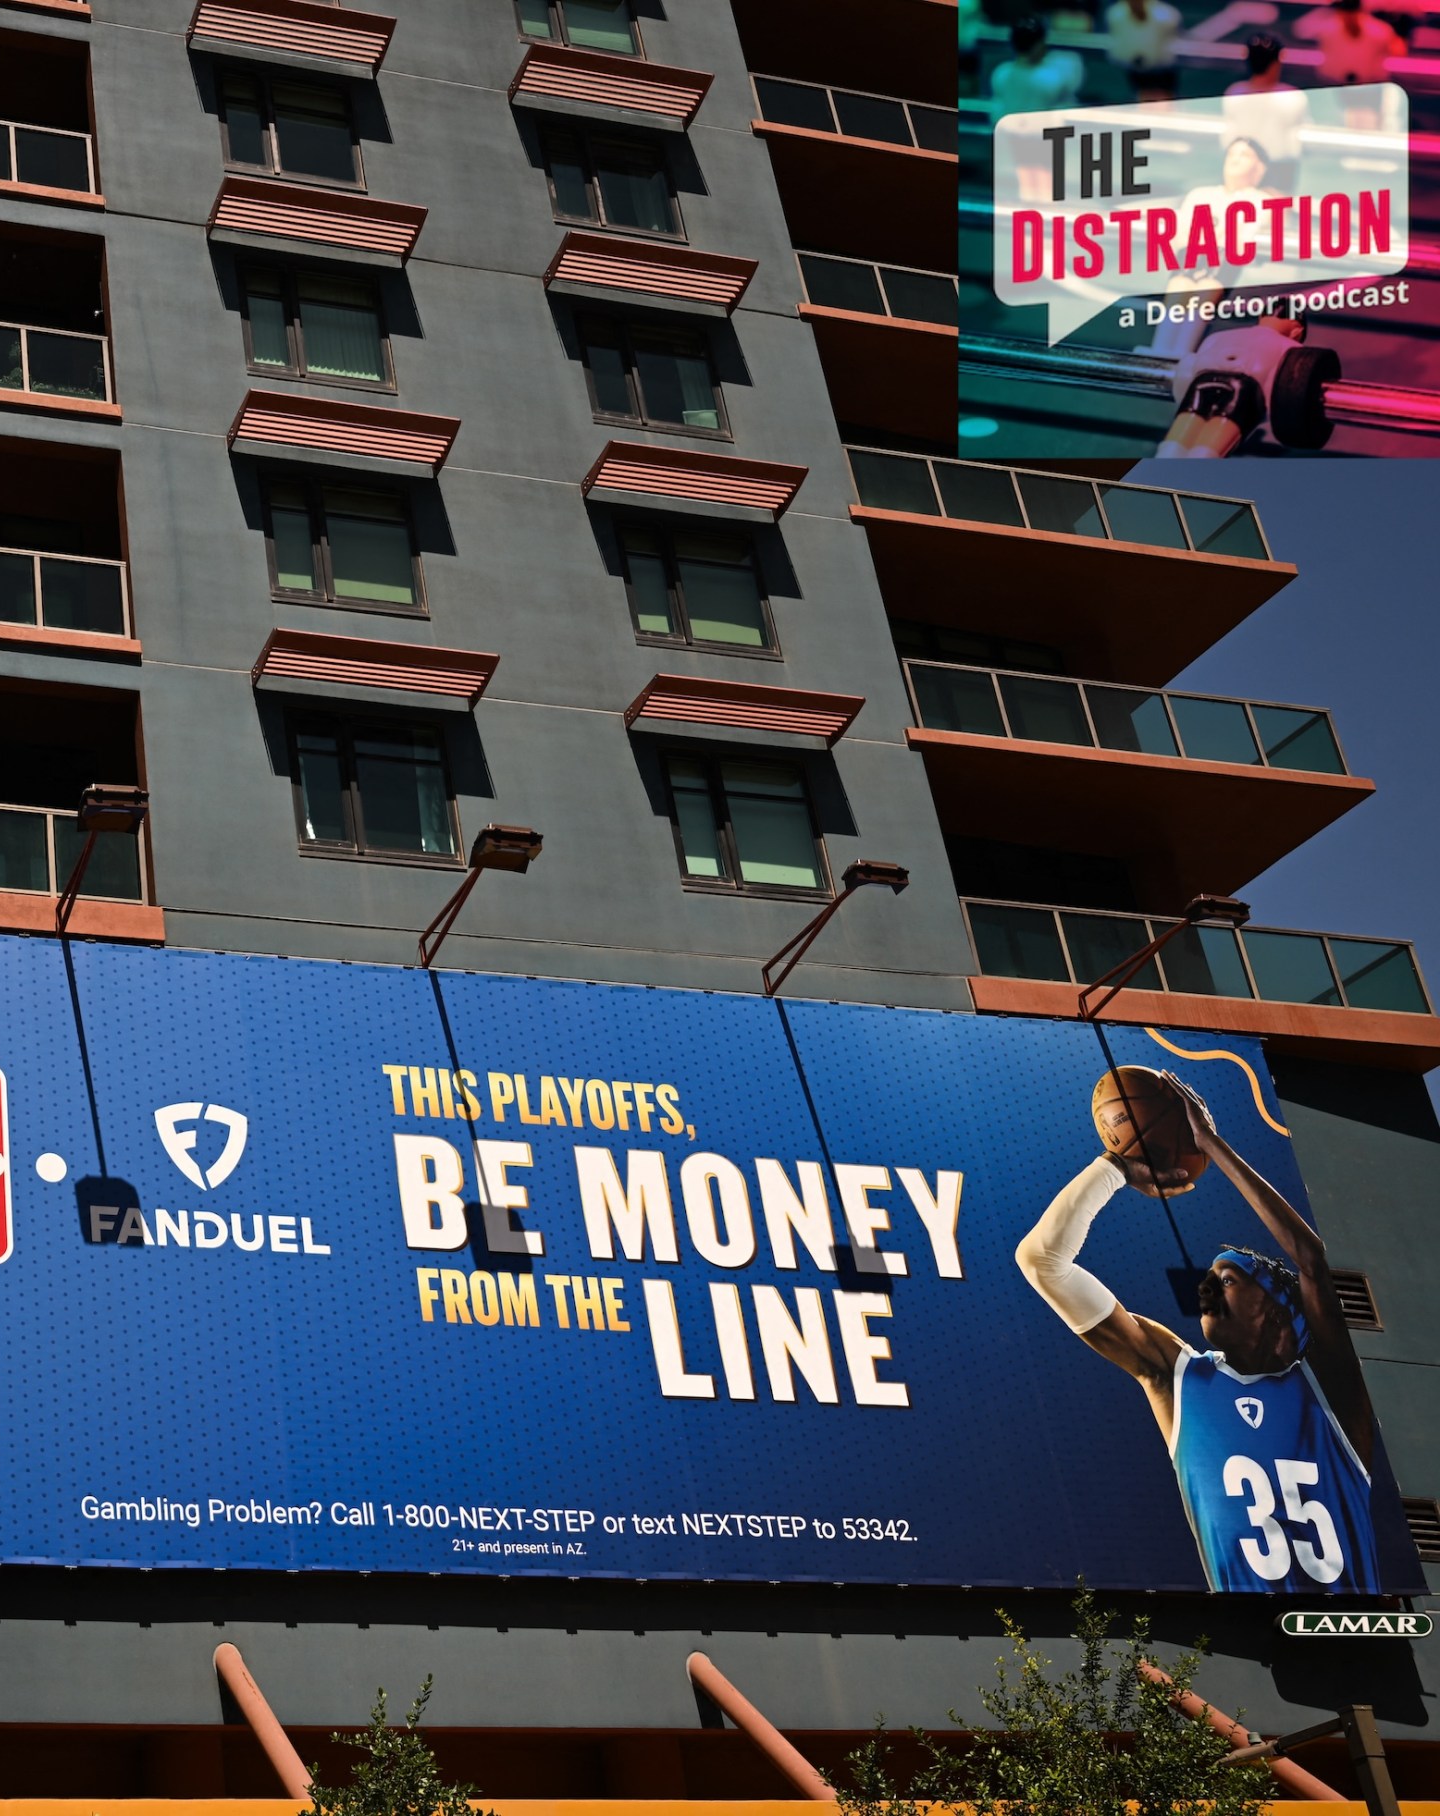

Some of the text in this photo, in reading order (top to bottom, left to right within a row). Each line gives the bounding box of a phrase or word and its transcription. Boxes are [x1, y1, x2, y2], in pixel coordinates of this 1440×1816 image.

[382, 1064, 698, 1141] THIS PLAYOFFS,
[89, 1205, 331, 1255] FANDUEL
[392, 1133, 965, 1281] BE MONEY
[415, 1267, 631, 1332] FROM THE
[641, 1279, 913, 1408] LINE
[81, 1495, 918, 1542] Gambling Problem? Call 1-800-NEXT-STEP or text NEXTSTEP to 53342.
[452, 1539, 587, 1556] 21+ and present in AZ.
[1222, 1455, 1345, 1584] 35
[1296, 1616, 1417, 1633] LAMAR
